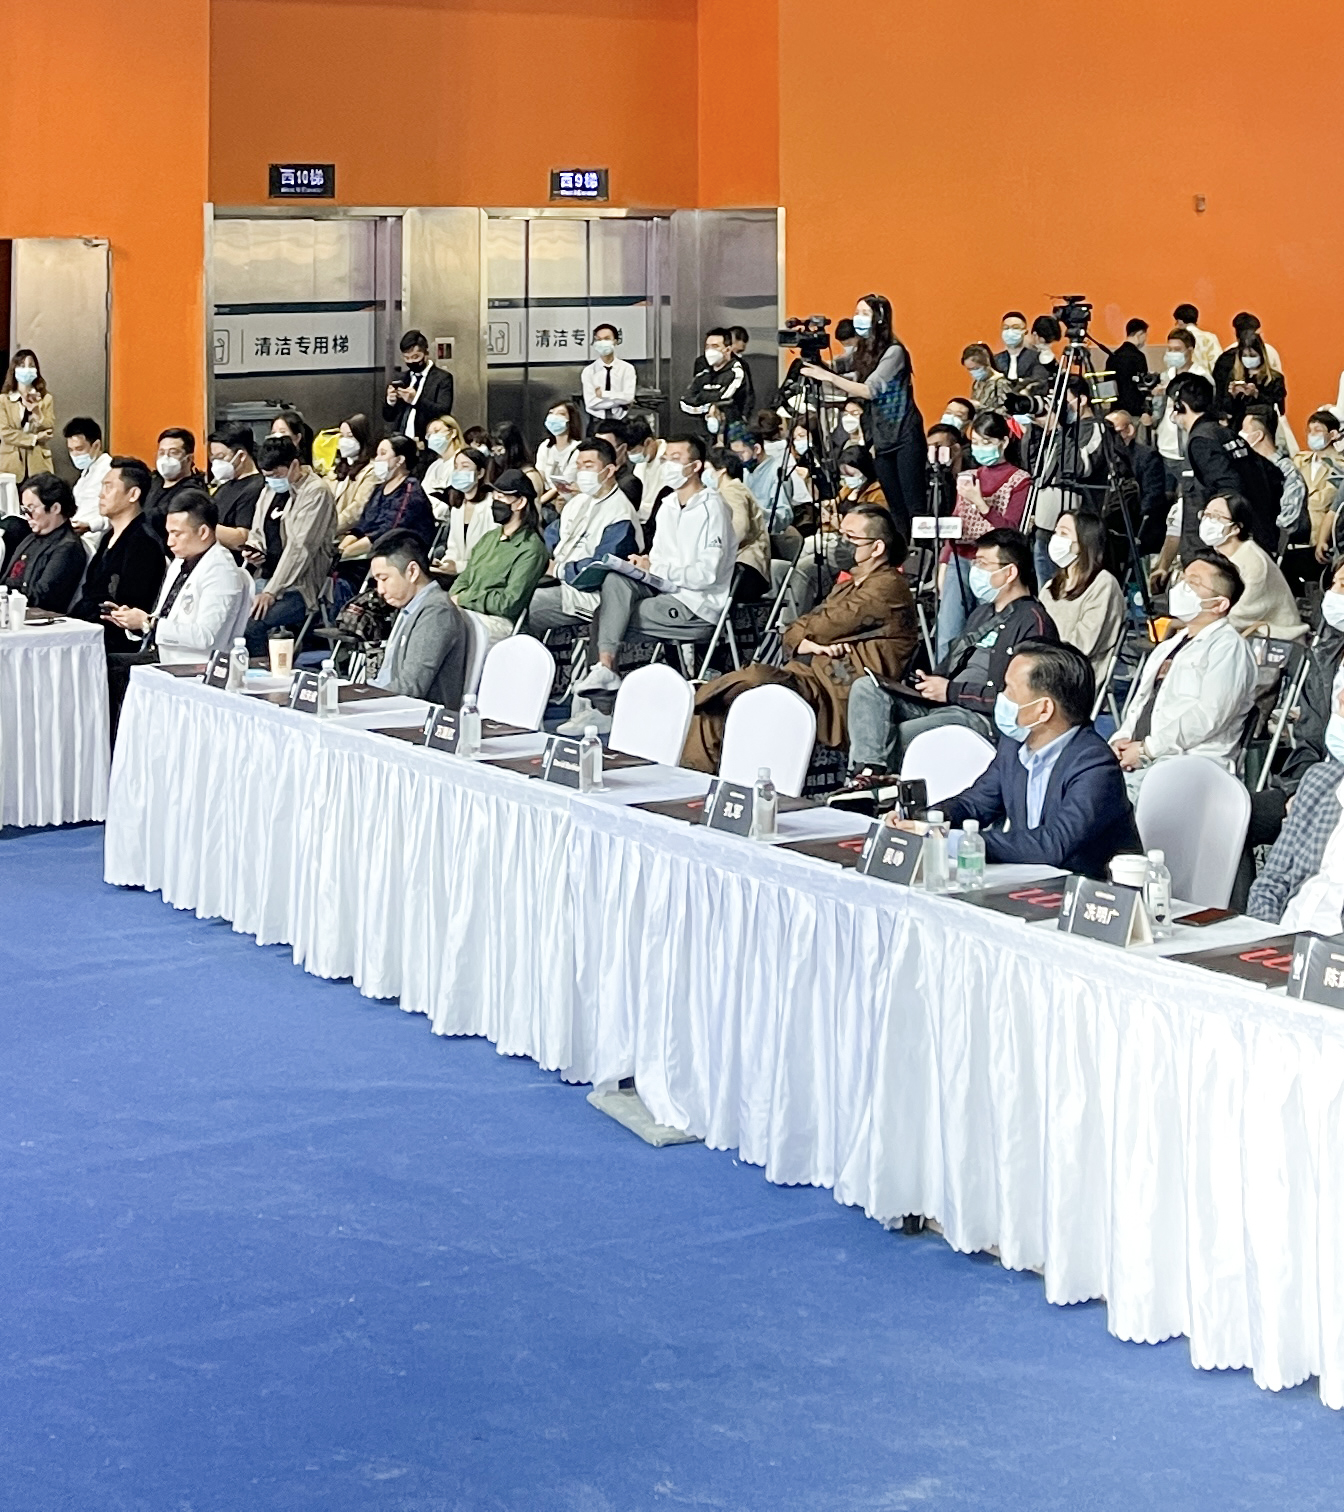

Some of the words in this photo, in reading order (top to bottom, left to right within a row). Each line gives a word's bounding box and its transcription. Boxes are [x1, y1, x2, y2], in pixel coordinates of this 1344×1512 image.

[279, 168, 324, 186] 西10梯
[559, 172, 598, 189] 西9梯
[254, 334, 350, 356] 清洁专用梯
[535, 328, 623, 348] 清洁专
